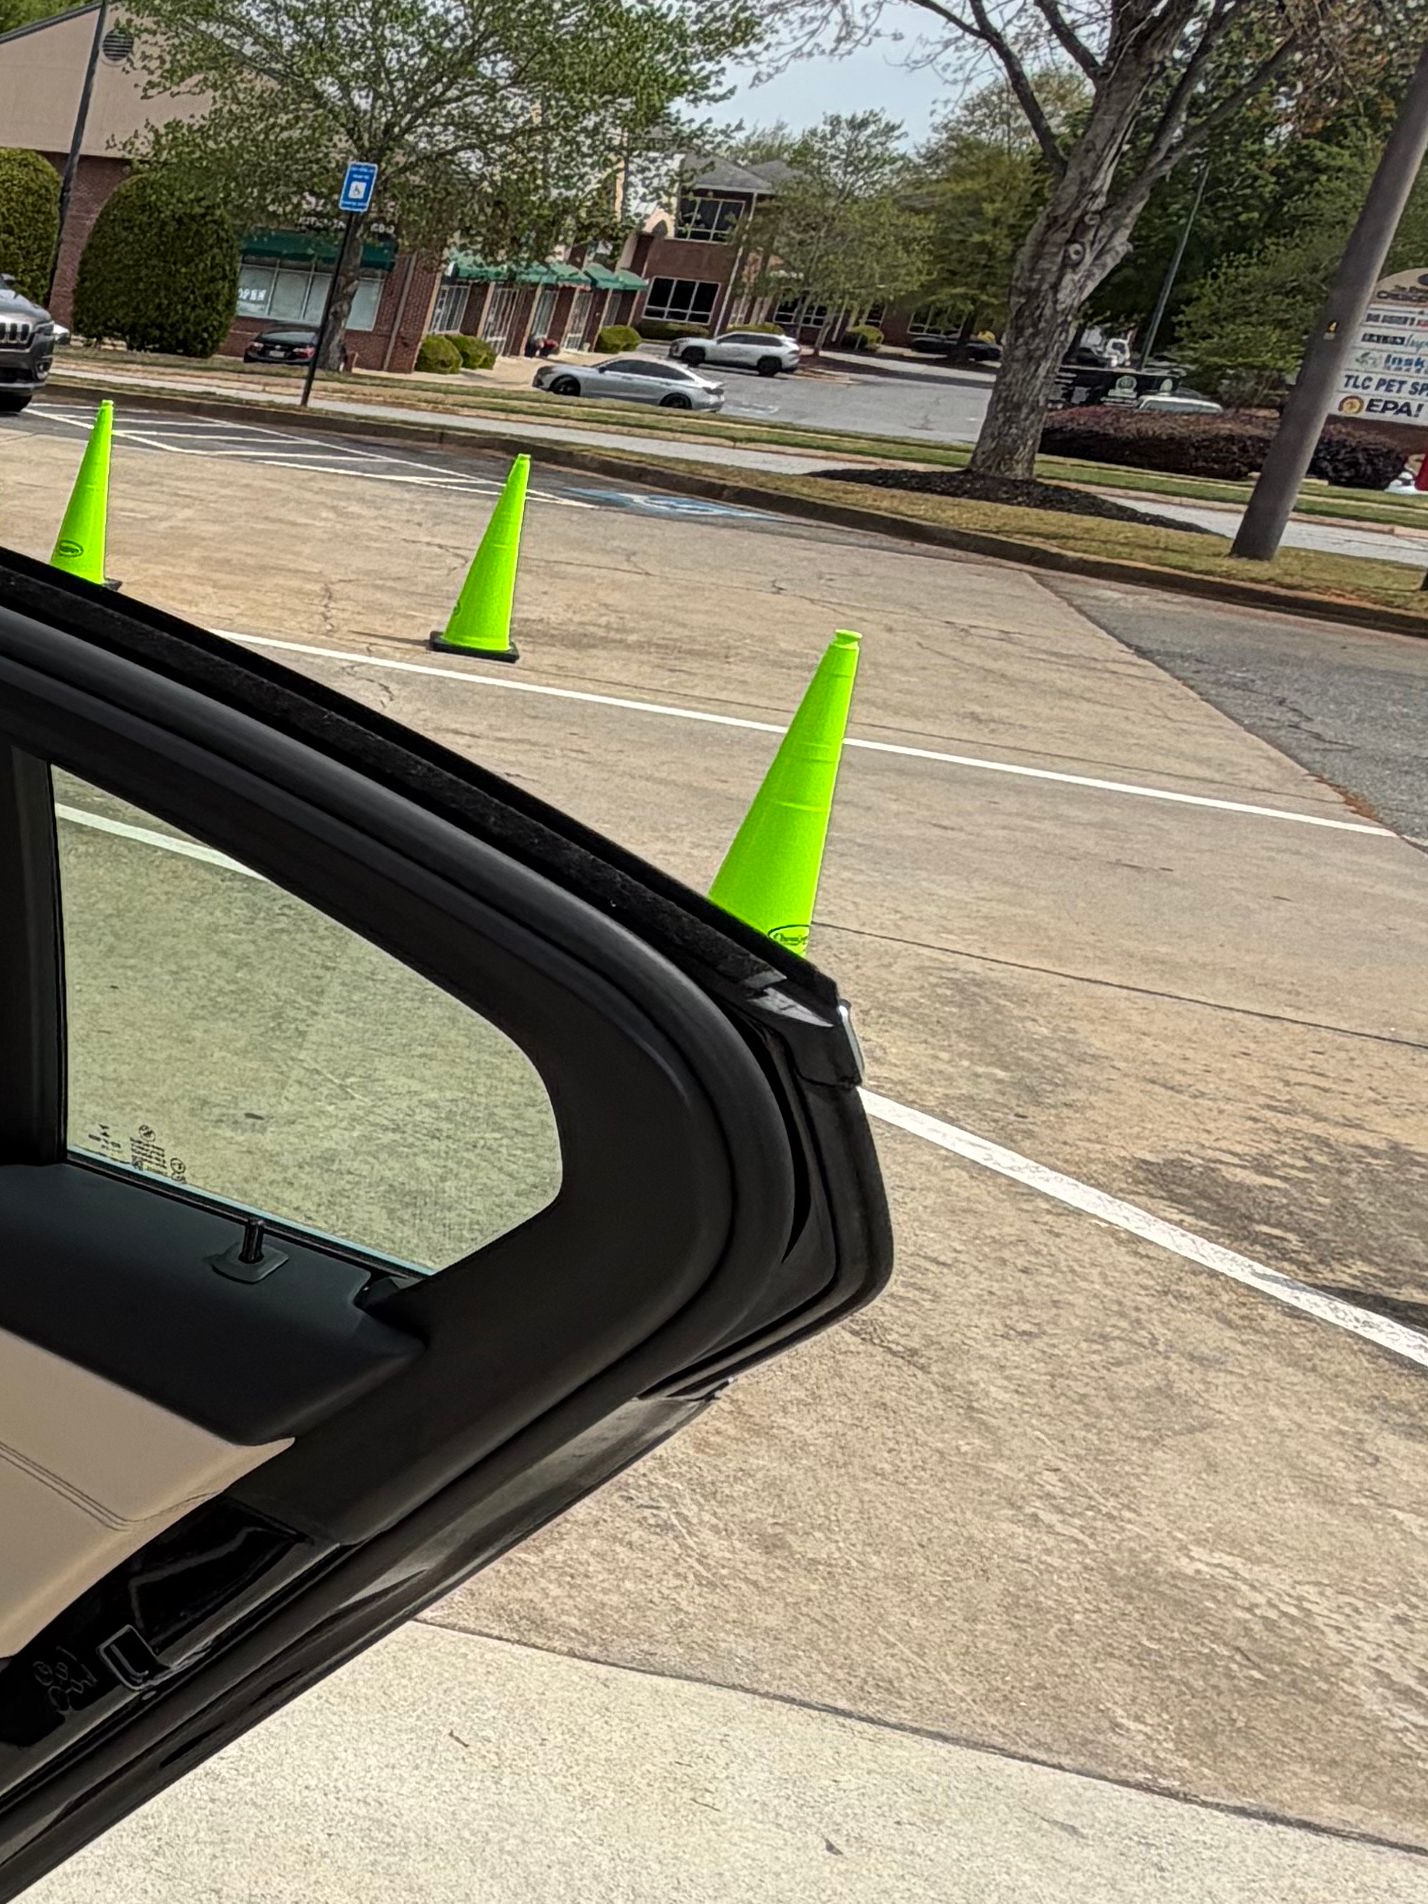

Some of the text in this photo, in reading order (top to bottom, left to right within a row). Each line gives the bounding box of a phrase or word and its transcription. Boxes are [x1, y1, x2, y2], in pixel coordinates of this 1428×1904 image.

[1344, 374, 1428, 396] TLC PET SP
[1365, 398, 1425, 418] EPA!
